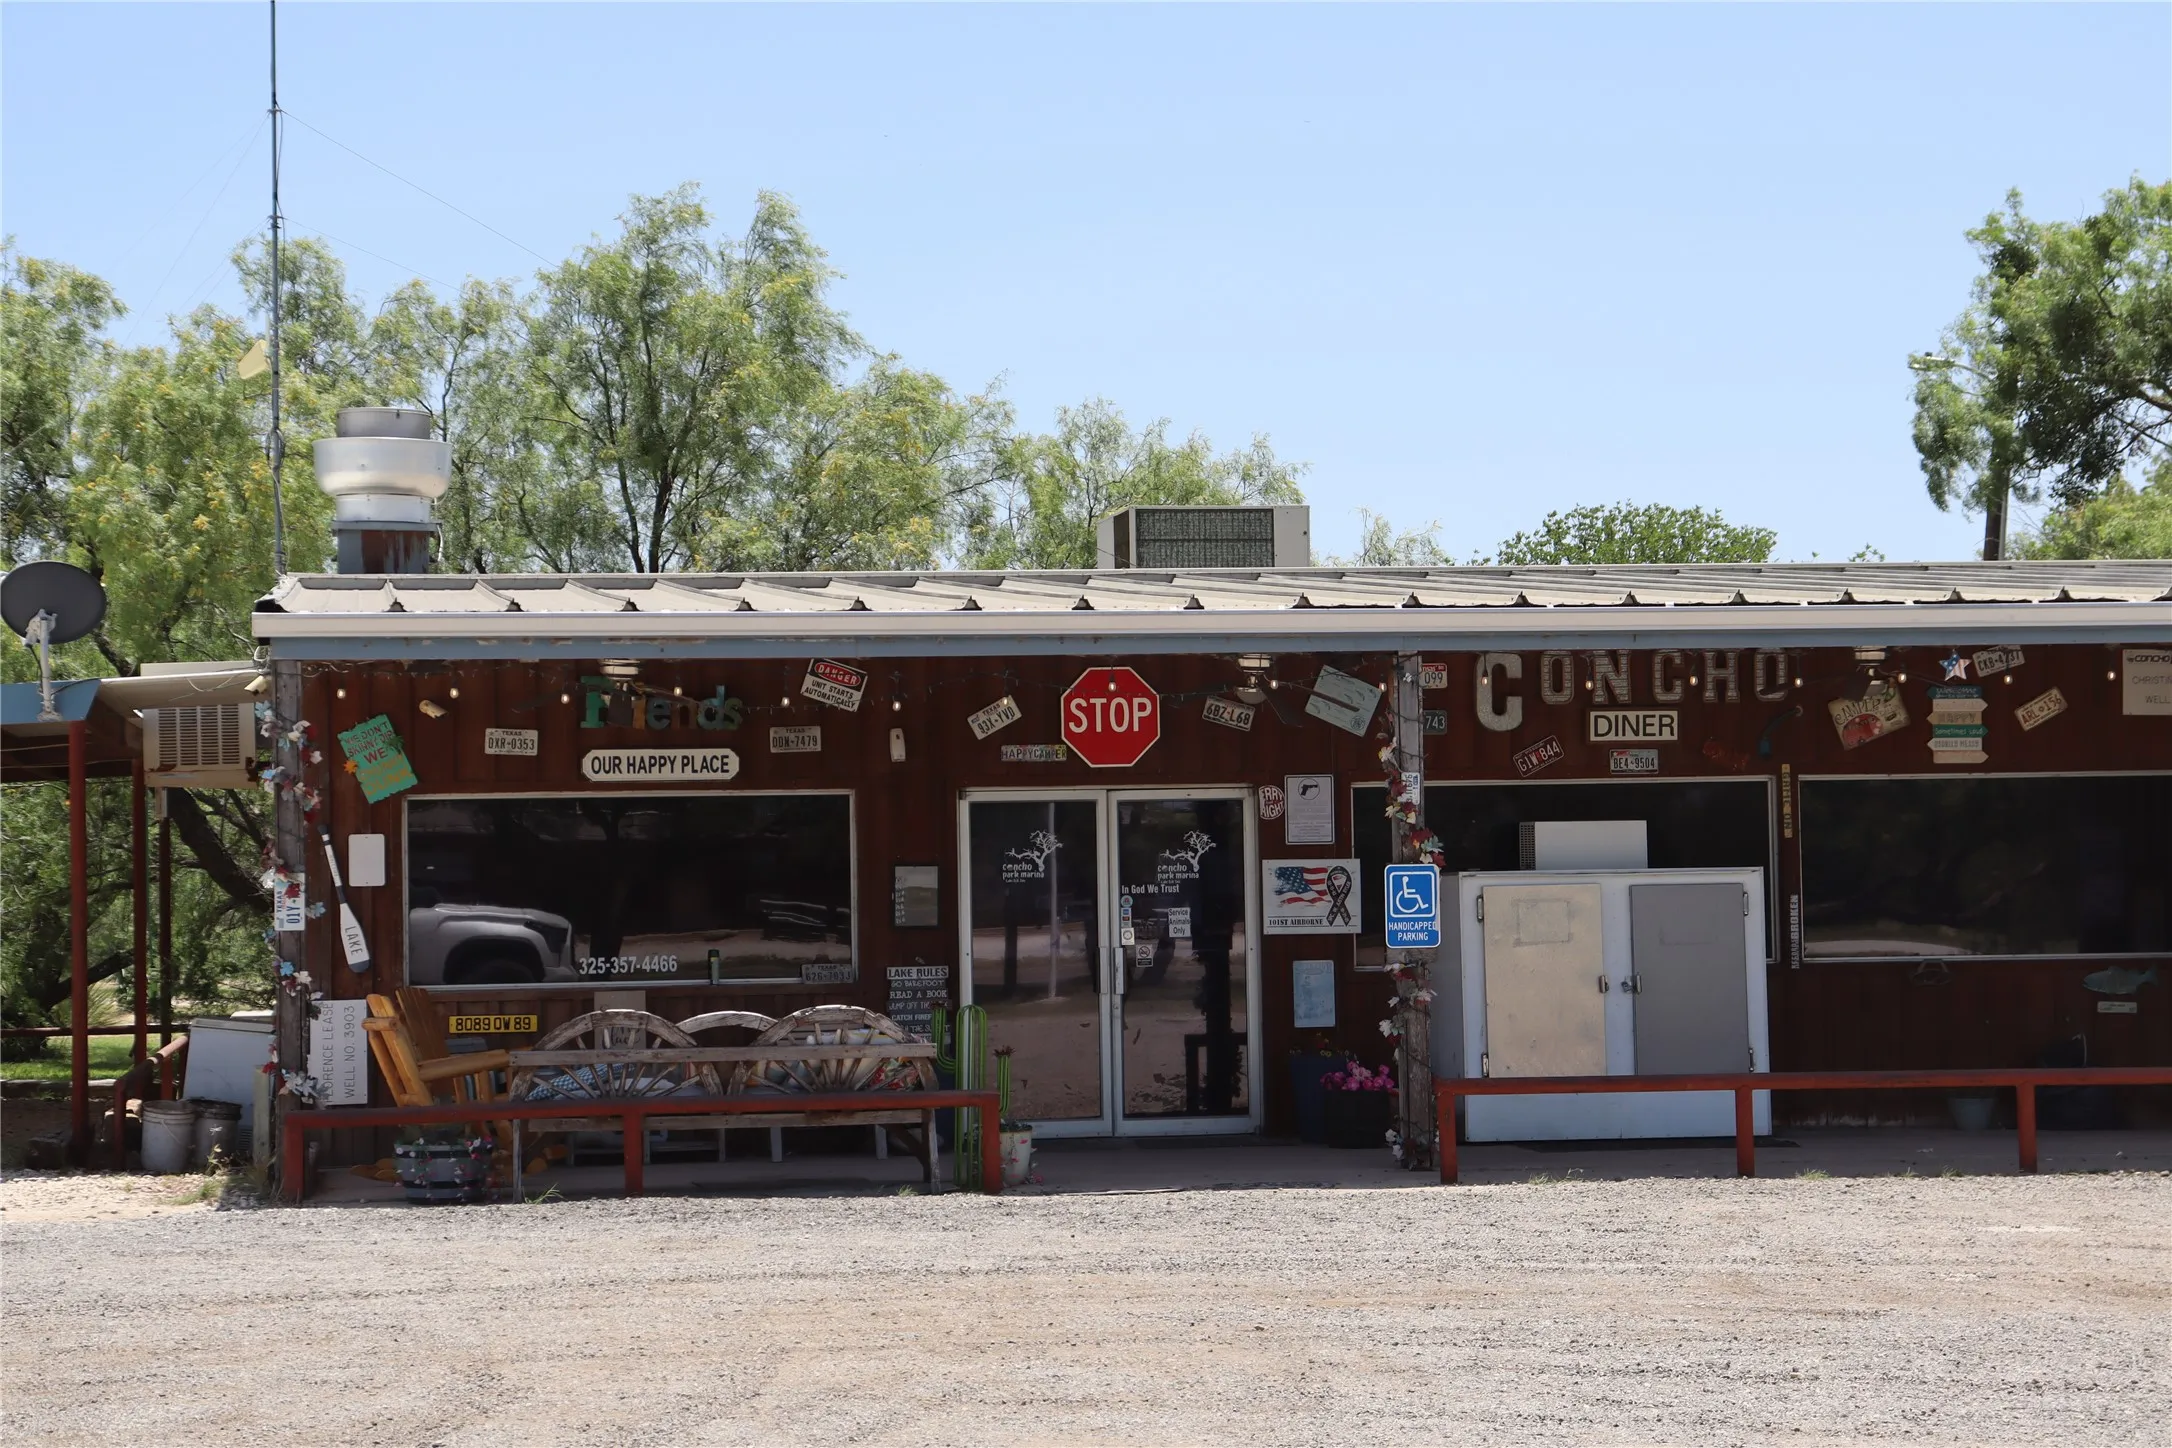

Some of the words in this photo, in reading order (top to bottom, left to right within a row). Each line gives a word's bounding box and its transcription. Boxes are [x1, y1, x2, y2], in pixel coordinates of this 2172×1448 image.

[818, 664, 857, 685] DANGER
[811, 679, 827, 690] UNIT
[828, 685, 854, 699] STARTS
[804, 686, 856, 709] AUTOMATICALLY
[1068, 696, 1152, 734] STOP
[1593, 715, 1675, 738] DINER
[364, 746, 389, 765] WE
[591, 756, 622, 774] OUR
[626, 755, 677, 774] HAPPY
[681, 754, 730, 773] PLACE
[1002, 861, 1032, 871] concho
[1157, 863, 1187, 872] concho
[1002, 870, 1020, 880] park
[1020, 869, 1045, 878] marina
[1157, 872, 1174, 881] park
[1175, 871, 1199, 879] marina
[1121, 885, 1129, 894] In
[1131, 885, 1145, 894] God
[1147, 884, 1159, 893] We
[1161, 883, 1180, 893] Trust
[1168, 908, 1188, 917] Service
[1168, 917, 1191, 925] Animals
[1389, 921, 1437, 931] HANDICAPPED
[1173, 926, 1186, 935] Only
[1398, 932, 1429, 941] PARKING
[344, 925, 363, 955] LAKE
[579, 955, 678, 975] 325-357-4466
[888, 968, 913, 978] LAKE
[916, 967, 948, 977] RULES
[889, 991, 912, 999] READ
[926, 990, 947, 998] BOOK
[322, 1003, 334, 1040] LEASE
[343, 1005, 355, 1038] 3903
[455, 1017, 491, 1031] 8089
[514, 1017, 531, 1030] 89
[343, 1042, 355, 1062] NO.
[343, 1066, 355, 1099] WELL
